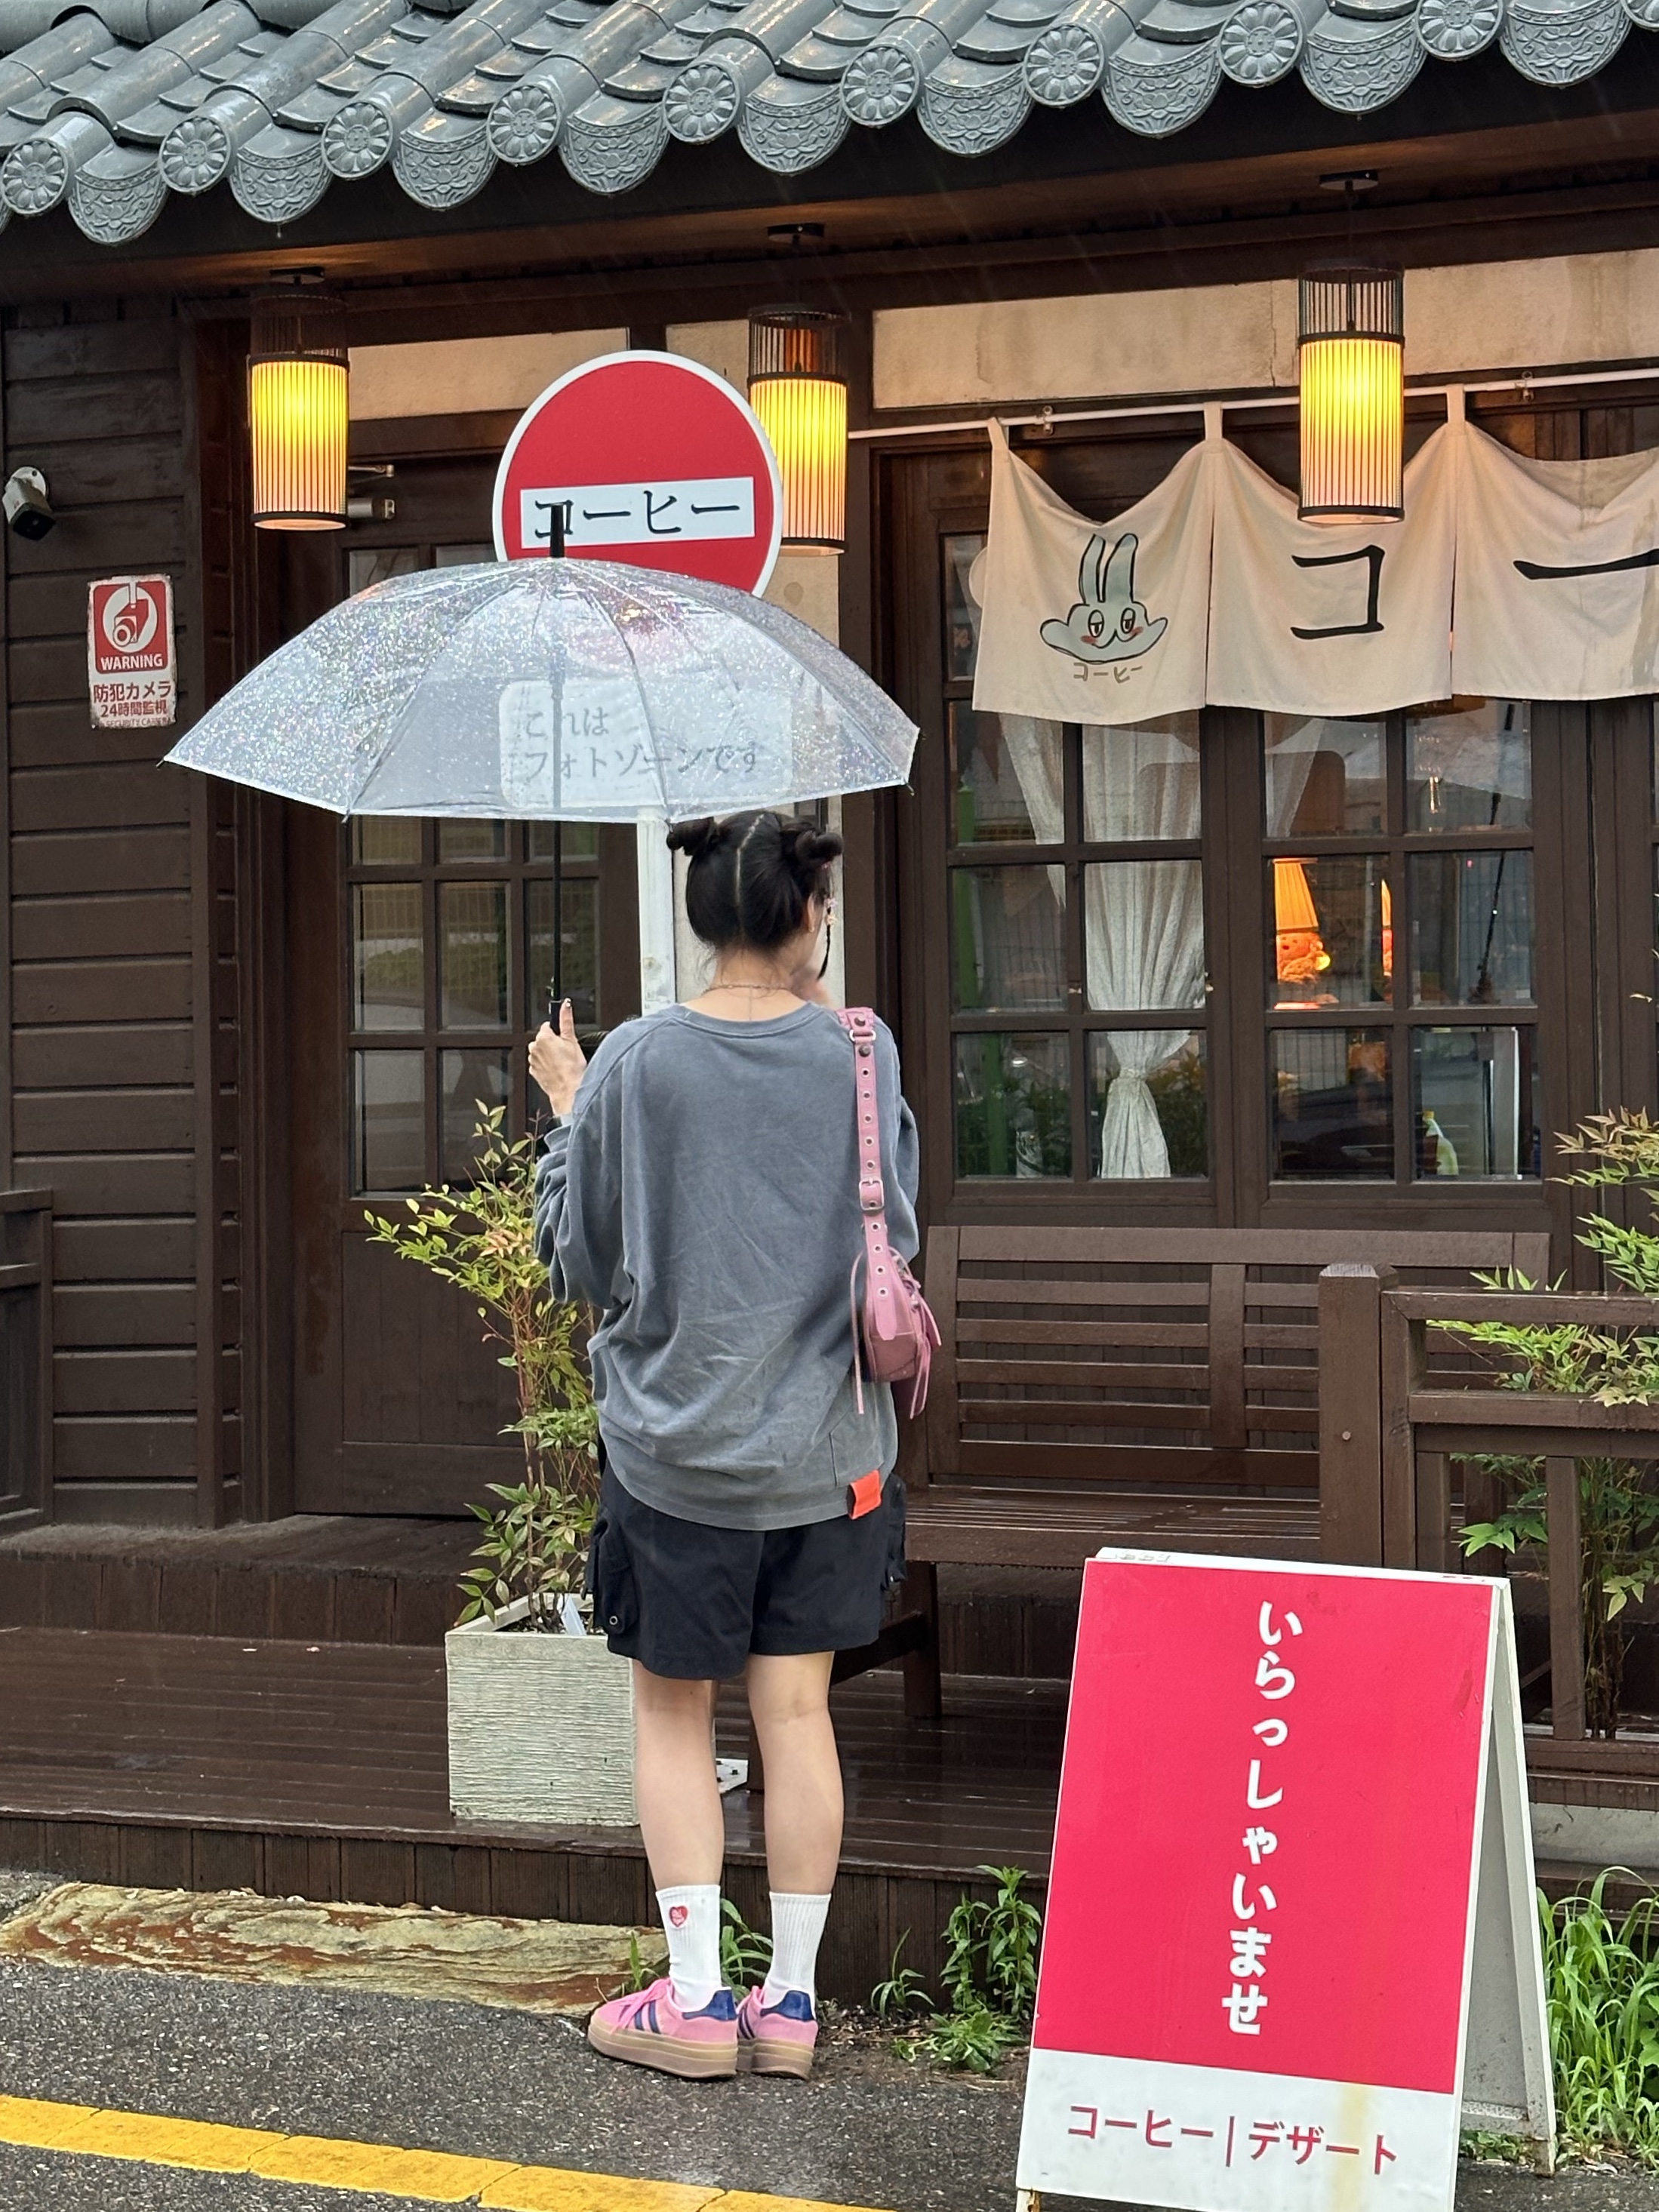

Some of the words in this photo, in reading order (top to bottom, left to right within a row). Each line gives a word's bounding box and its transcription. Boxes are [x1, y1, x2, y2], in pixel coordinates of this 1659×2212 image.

[534, 490, 740, 538] コーヒー
[100, 654, 163, 670] WARNING
[1073, 662, 1143, 684] コーヒー
[93, 681, 171, 703] 防犯カメラ
[100, 700, 168, 718] 24時間監視
[1221, 1600, 1304, 2035] いらっしゃいませ
